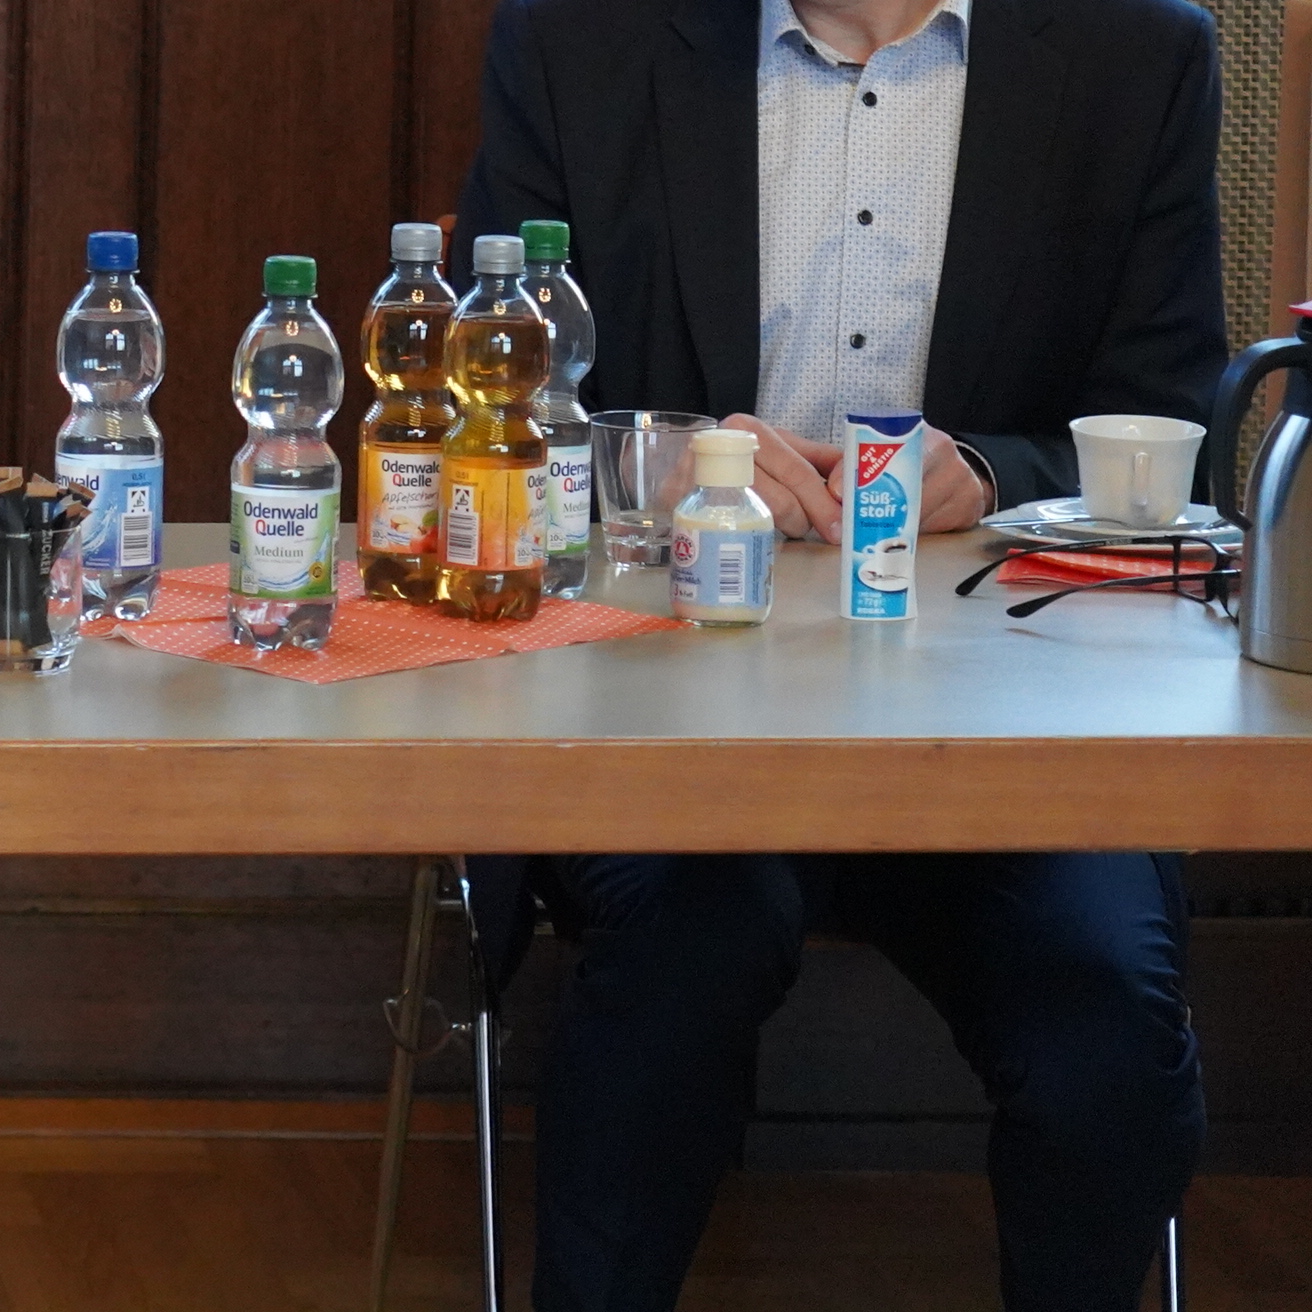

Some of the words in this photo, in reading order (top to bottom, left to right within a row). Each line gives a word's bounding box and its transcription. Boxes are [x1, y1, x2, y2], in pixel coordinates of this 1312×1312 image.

[861, 446, 876, 462] GUT
[392, 473, 432, 487] Quelle
[859, 490, 896, 505] Süß-
[243, 500, 319, 520] Odenwald
[859, 504, 897, 518] stoff
[255, 519, 305, 536] Quelle
[40, 529, 53, 576] ZUCKER
[254, 545, 304, 558] Medium
